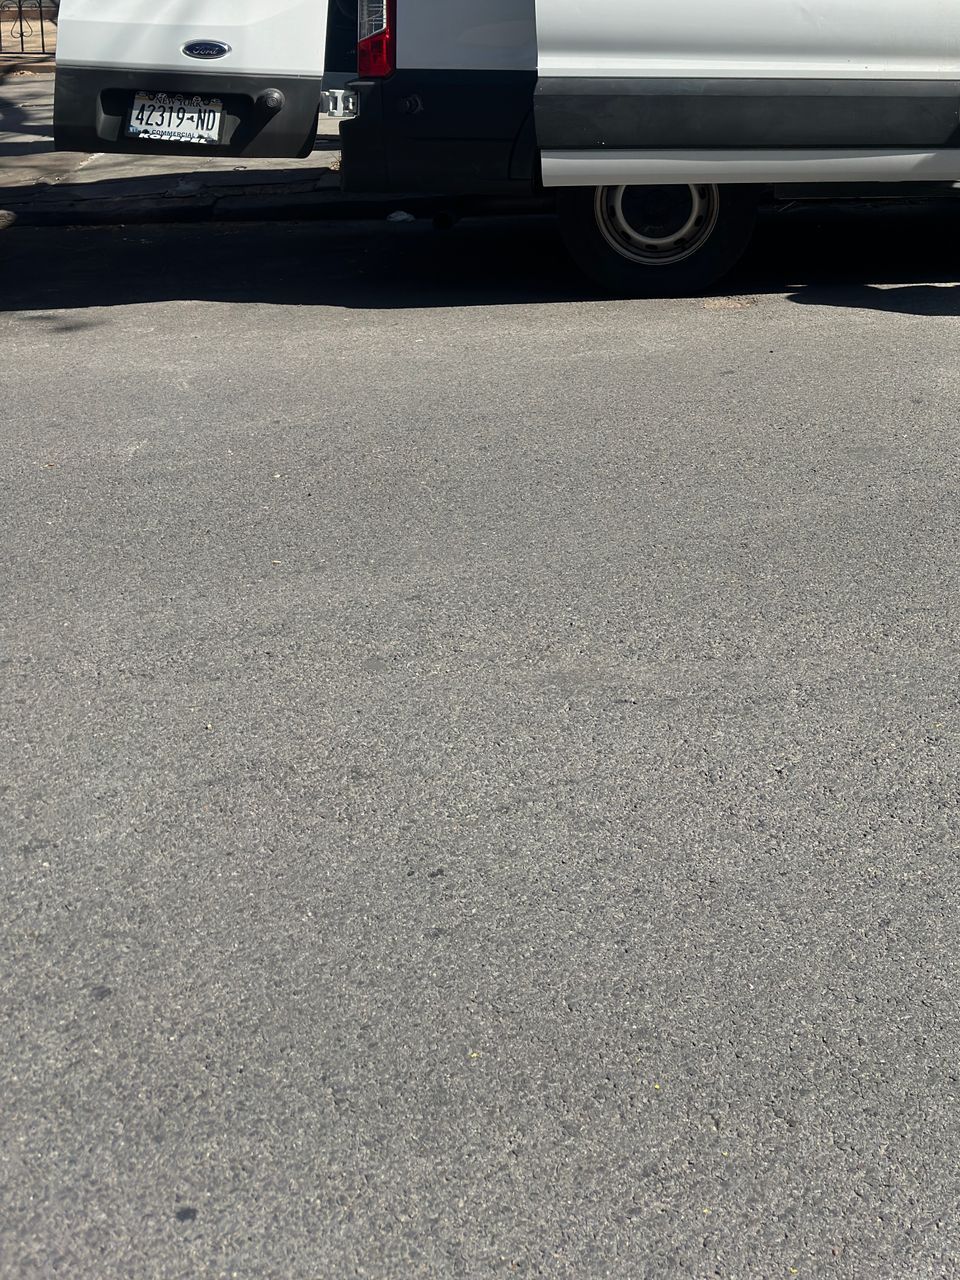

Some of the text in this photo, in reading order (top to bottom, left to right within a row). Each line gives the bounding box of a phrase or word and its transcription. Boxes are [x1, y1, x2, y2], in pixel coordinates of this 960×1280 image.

[193, 46, 219, 54] Ford
[155, 96, 202, 107] NEW YORK
[138, 133, 207, 144] KOEPPEL
[151, 129, 196, 138] COMMERCIAL
